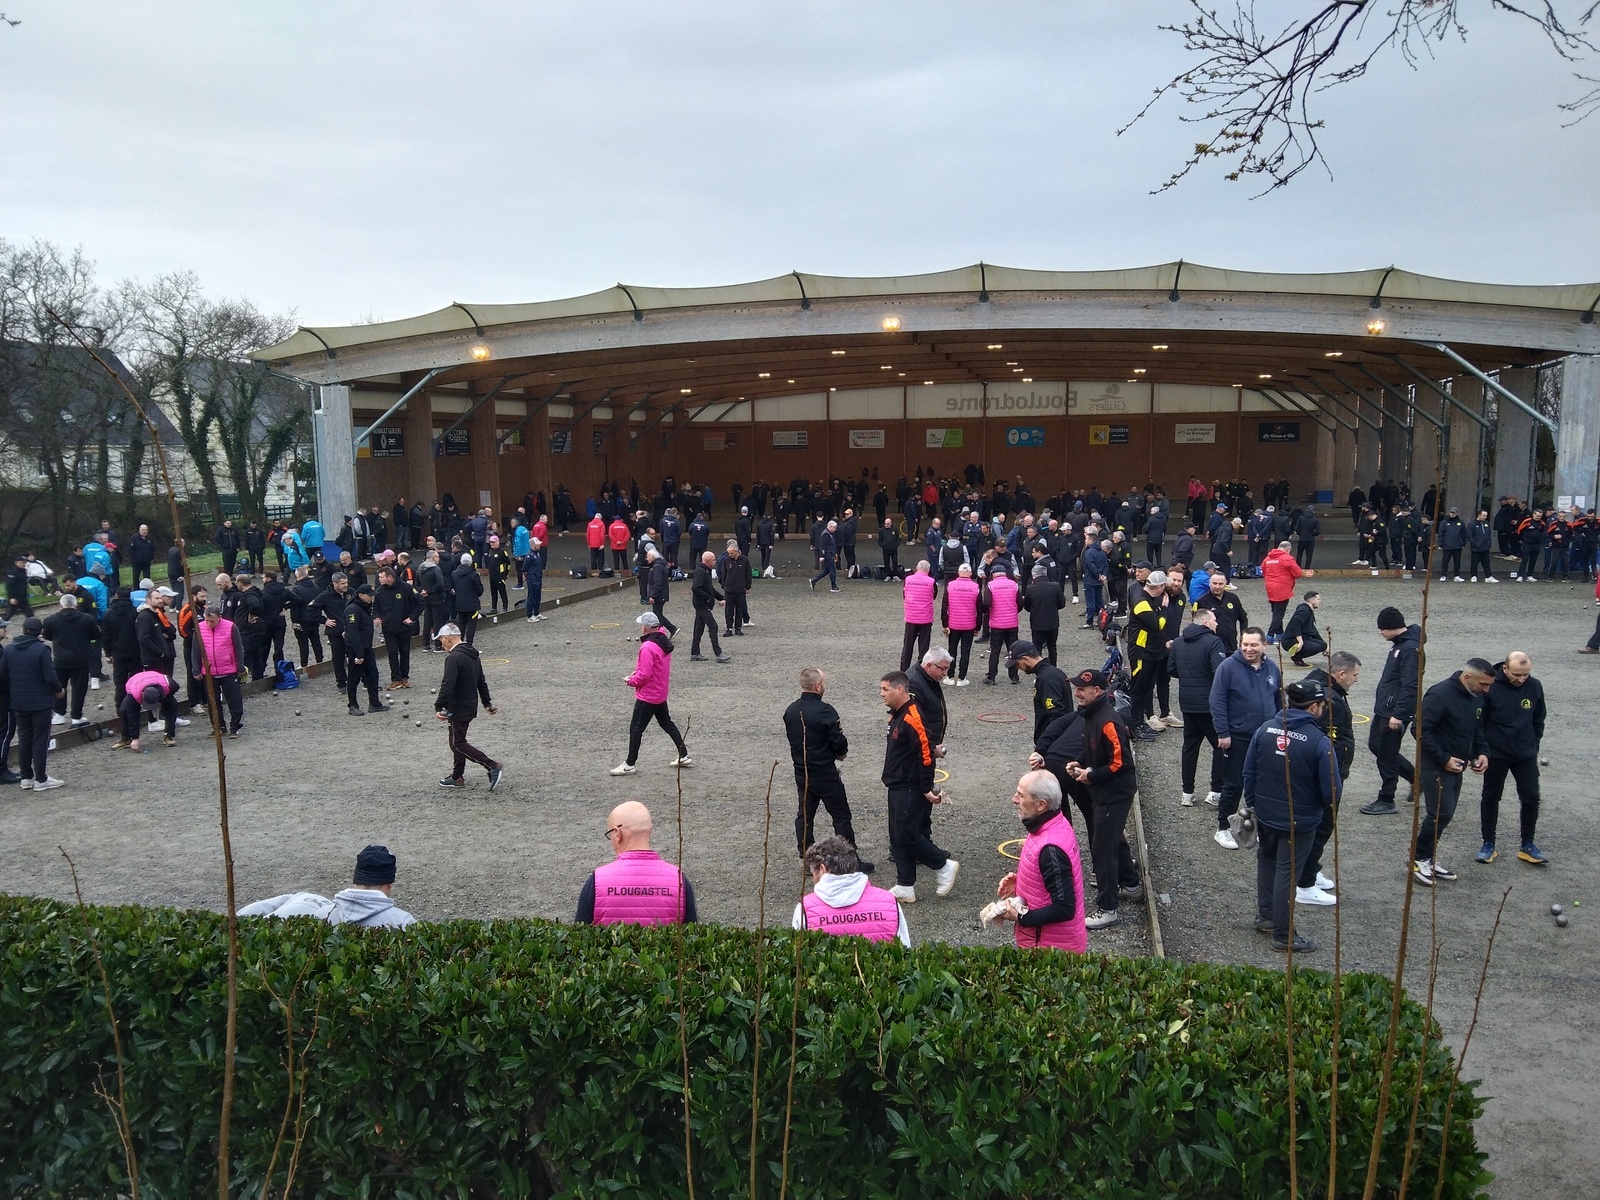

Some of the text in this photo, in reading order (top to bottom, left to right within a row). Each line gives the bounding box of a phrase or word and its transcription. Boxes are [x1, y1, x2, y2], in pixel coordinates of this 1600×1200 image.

[1287, 731, 1308, 742] ROSSO
[607, 886, 672, 897] PLOUGASTEL
[819, 912, 886, 926] PLOUGASTEL
